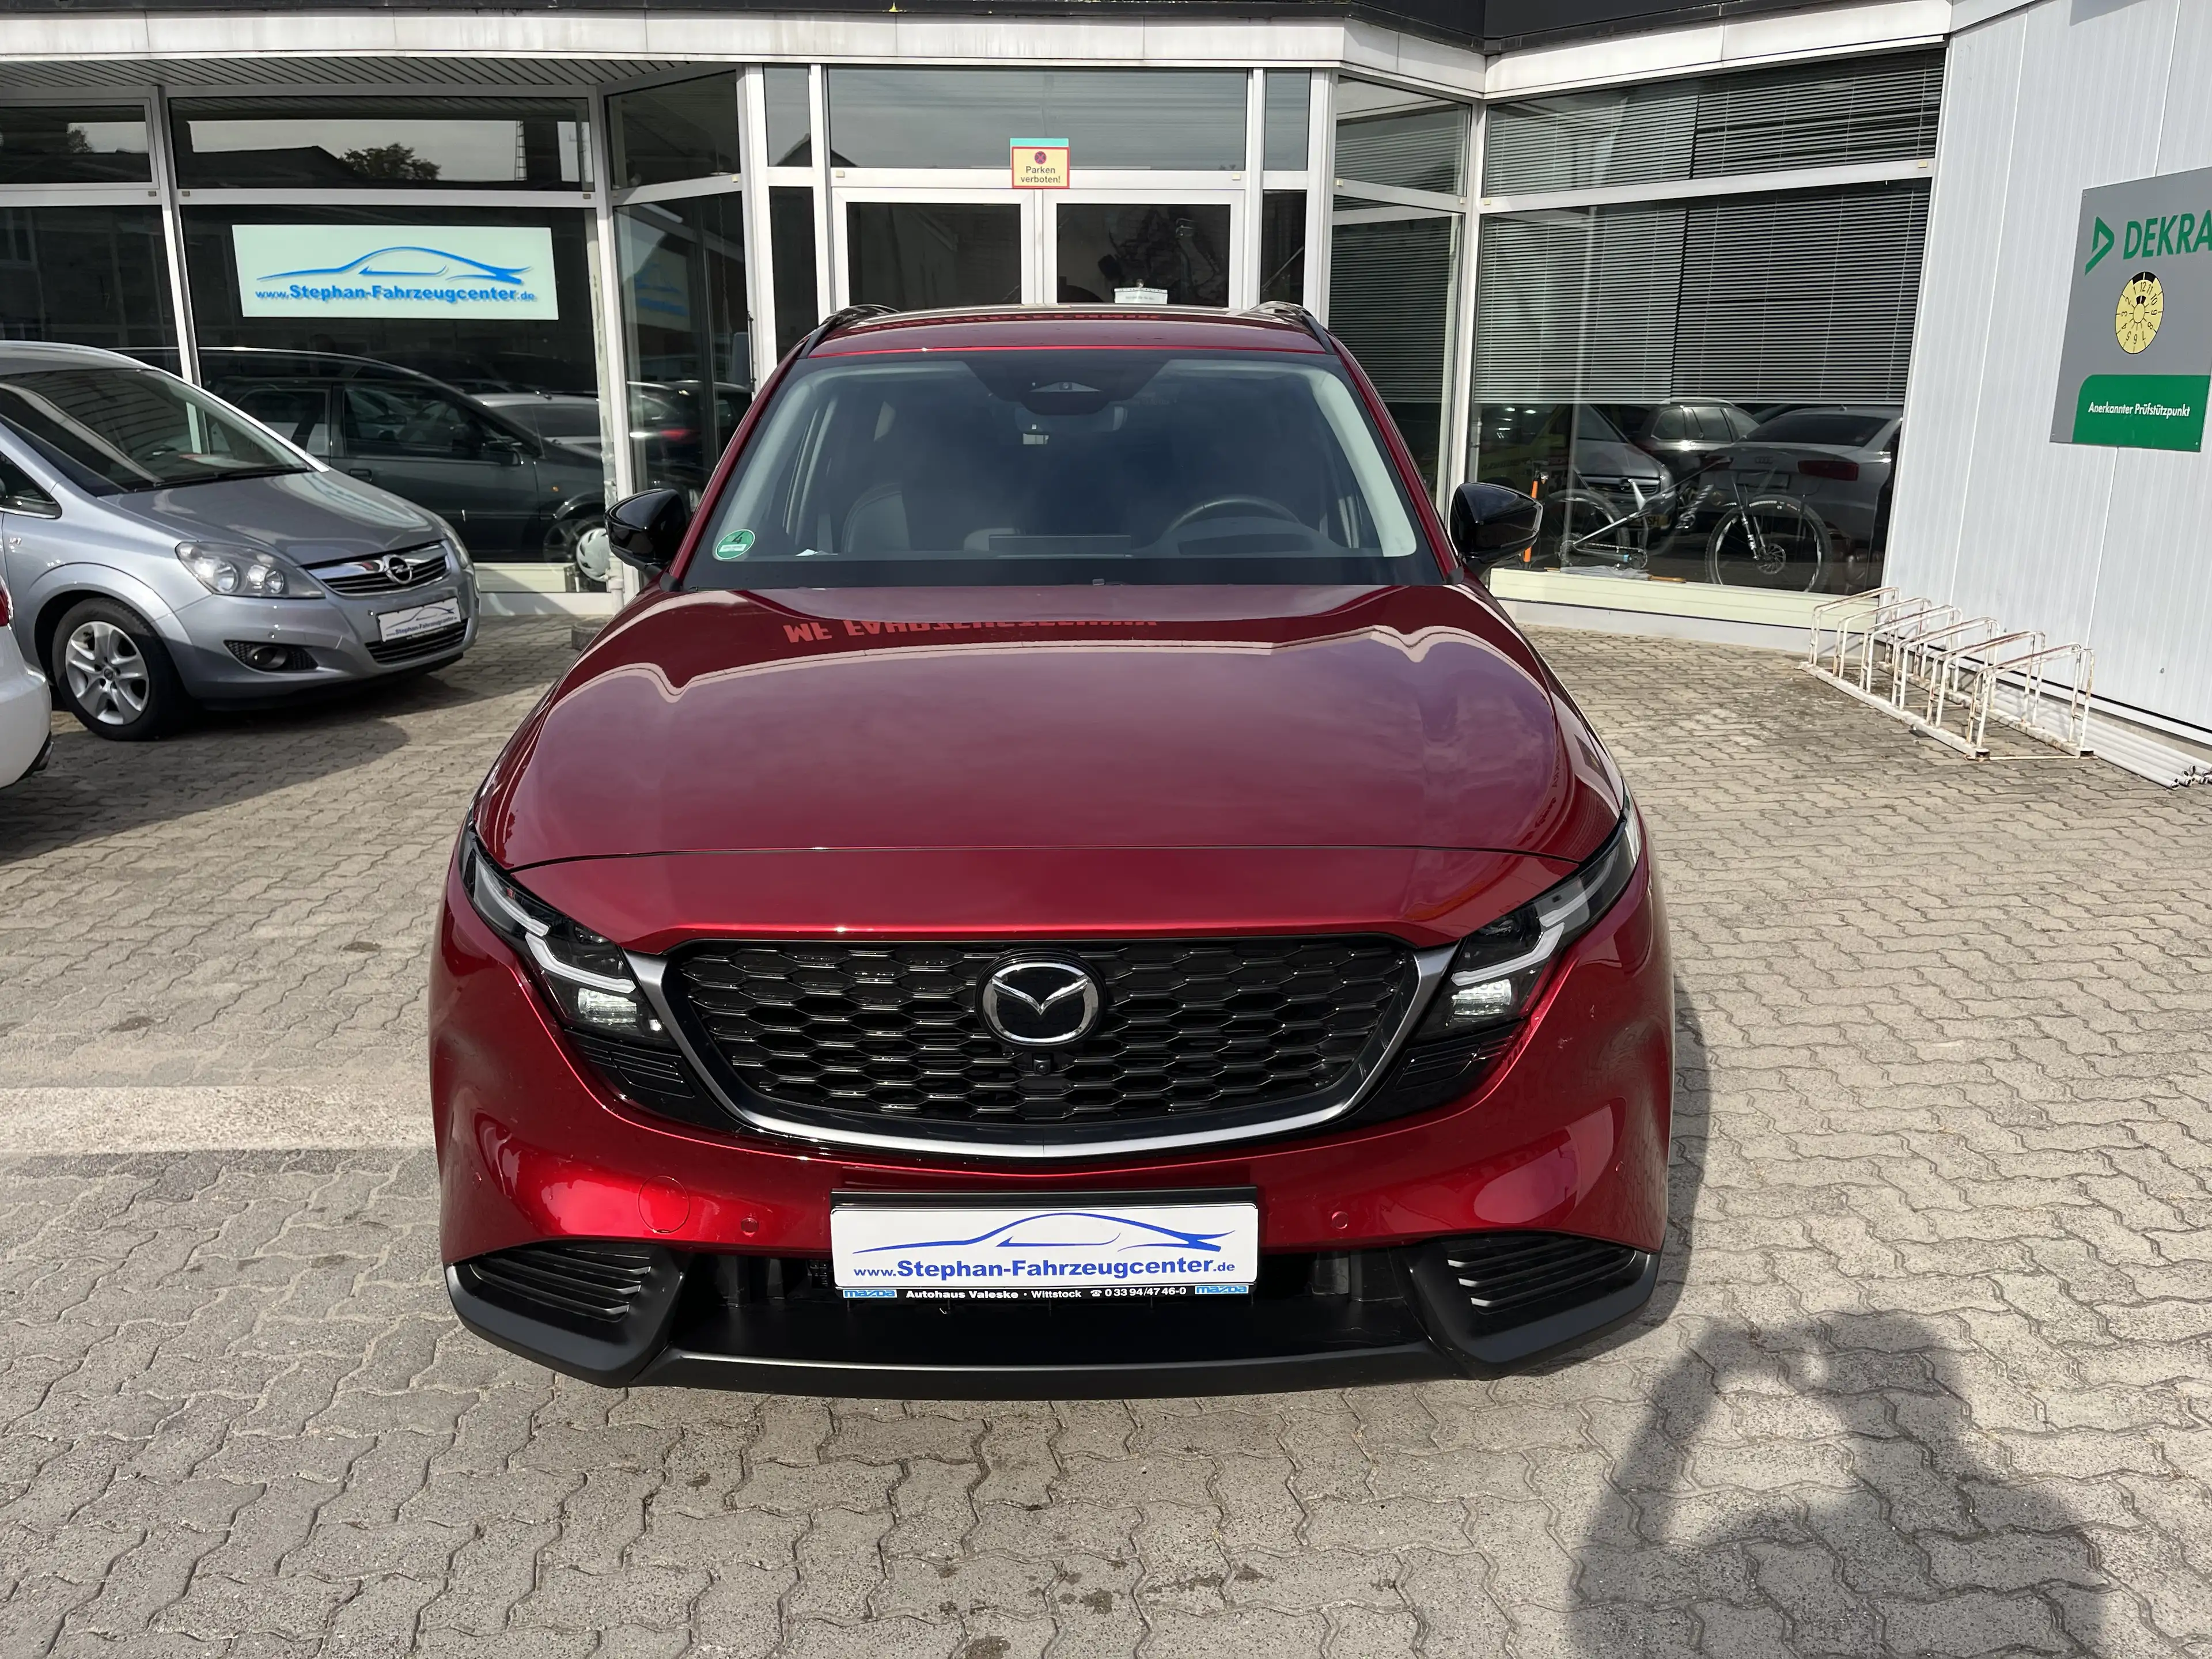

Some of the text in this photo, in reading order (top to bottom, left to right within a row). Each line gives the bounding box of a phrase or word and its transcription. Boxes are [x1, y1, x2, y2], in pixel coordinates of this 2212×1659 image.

[2123, 210, 2212, 259] DEKRA
[255, 284, 535, 303] www.Stephan-Fahrzeugcenter.de
[2088, 402, 2190, 419] Anerkannter Prüfstützpunkt
[731, 532, 744, 544] 4
[854, 1257, 1235, 1281] www.Stephan-Fahrzeugcenter.de
[906, 1290, 965, 1298] Autohaus
[970, 1290, 1018, 1298] Valeske
[1032, 1290, 1081, 1298] Wittstock
